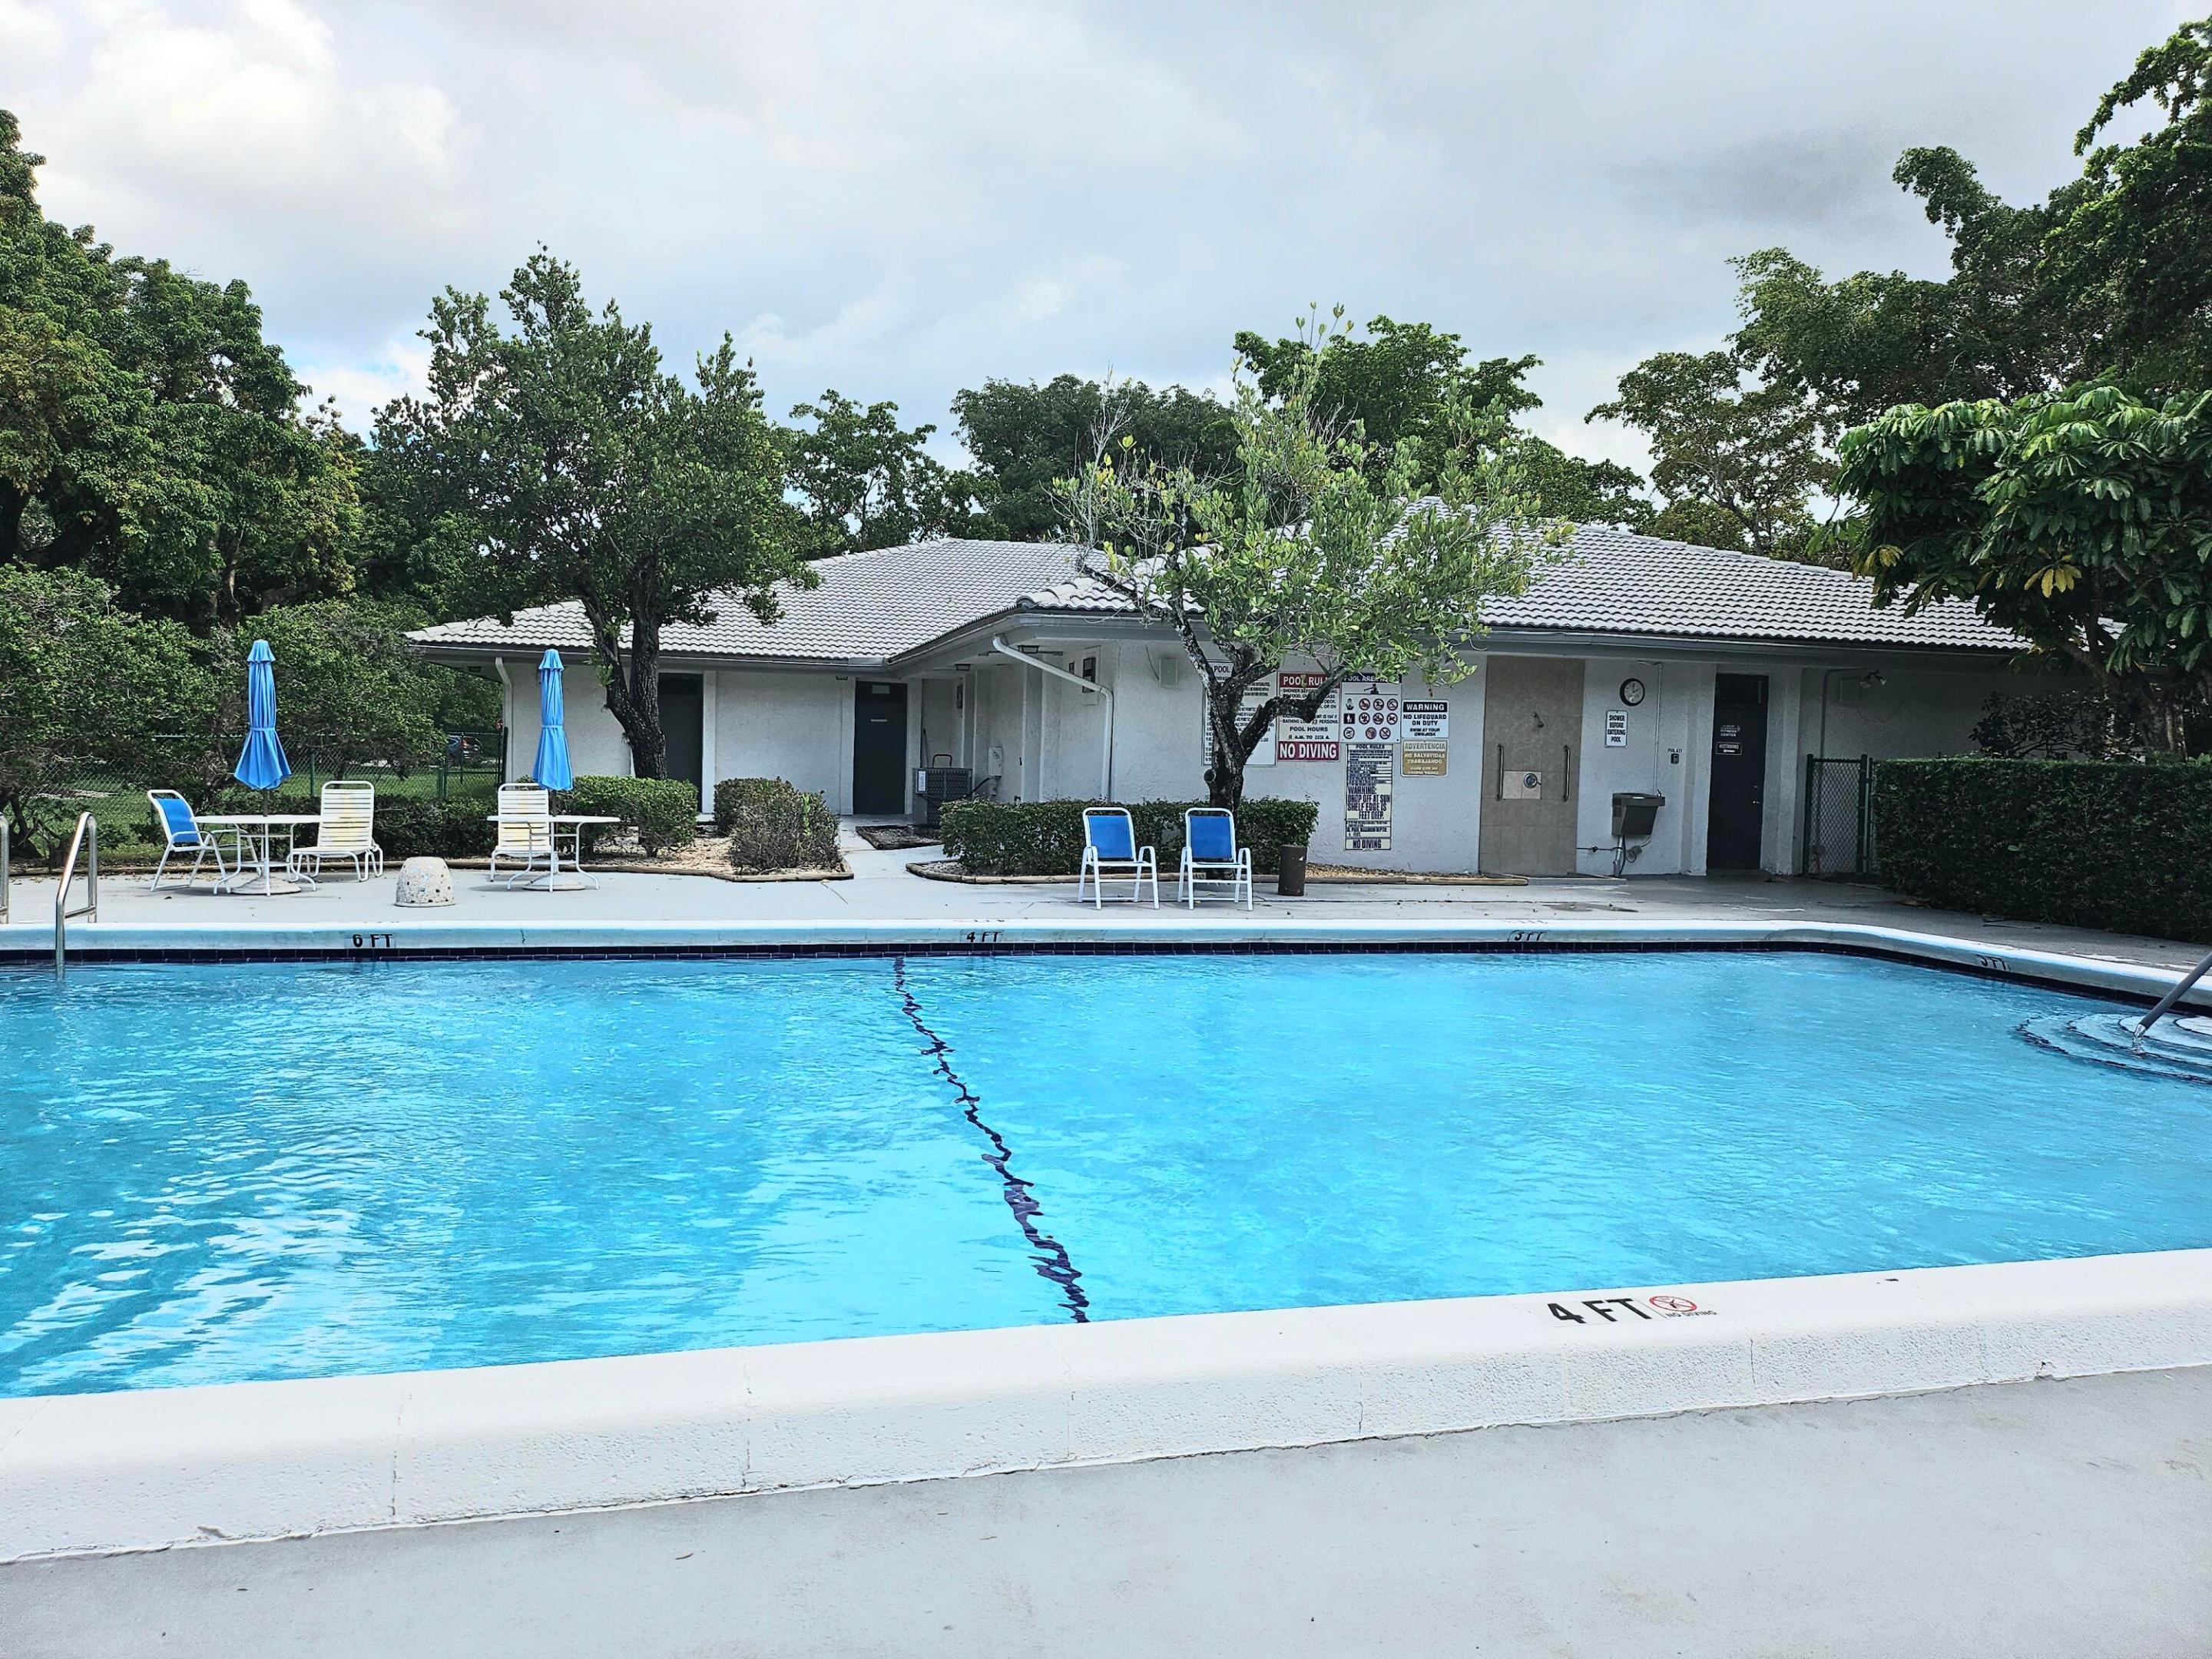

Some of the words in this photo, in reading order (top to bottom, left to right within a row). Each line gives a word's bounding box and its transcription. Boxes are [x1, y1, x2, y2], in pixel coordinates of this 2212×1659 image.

[1283, 676, 1307, 686] POOL
[1280, 743, 1296, 758] NO
[1299, 743, 1337, 759] DIVING
[1348, 794, 1362, 803] DROP
[1363, 794, 1373, 803] OFF
[1373, 794, 1379, 803] AT
[1380, 794, 1390, 803] SUN
[1347, 803, 1365, 811] SHELF
[1366, 803, 1380, 811] EDGE
[1381, 803, 1387, 811] IS
[1359, 811, 1370, 820] FEET
[1371, 811, 1384, 820] DEEP.
[1353, 839, 1361, 848] NO
[1362, 839, 1382, 849] DIVING
[352, 933, 363, 948] 6
[369, 933, 393, 948] FT
[966, 931, 976, 943] 4
[981, 931, 1002, 942] FT
[1547, 1303, 1587, 1324] 4
[1581, 1298, 1653, 1323] FT
